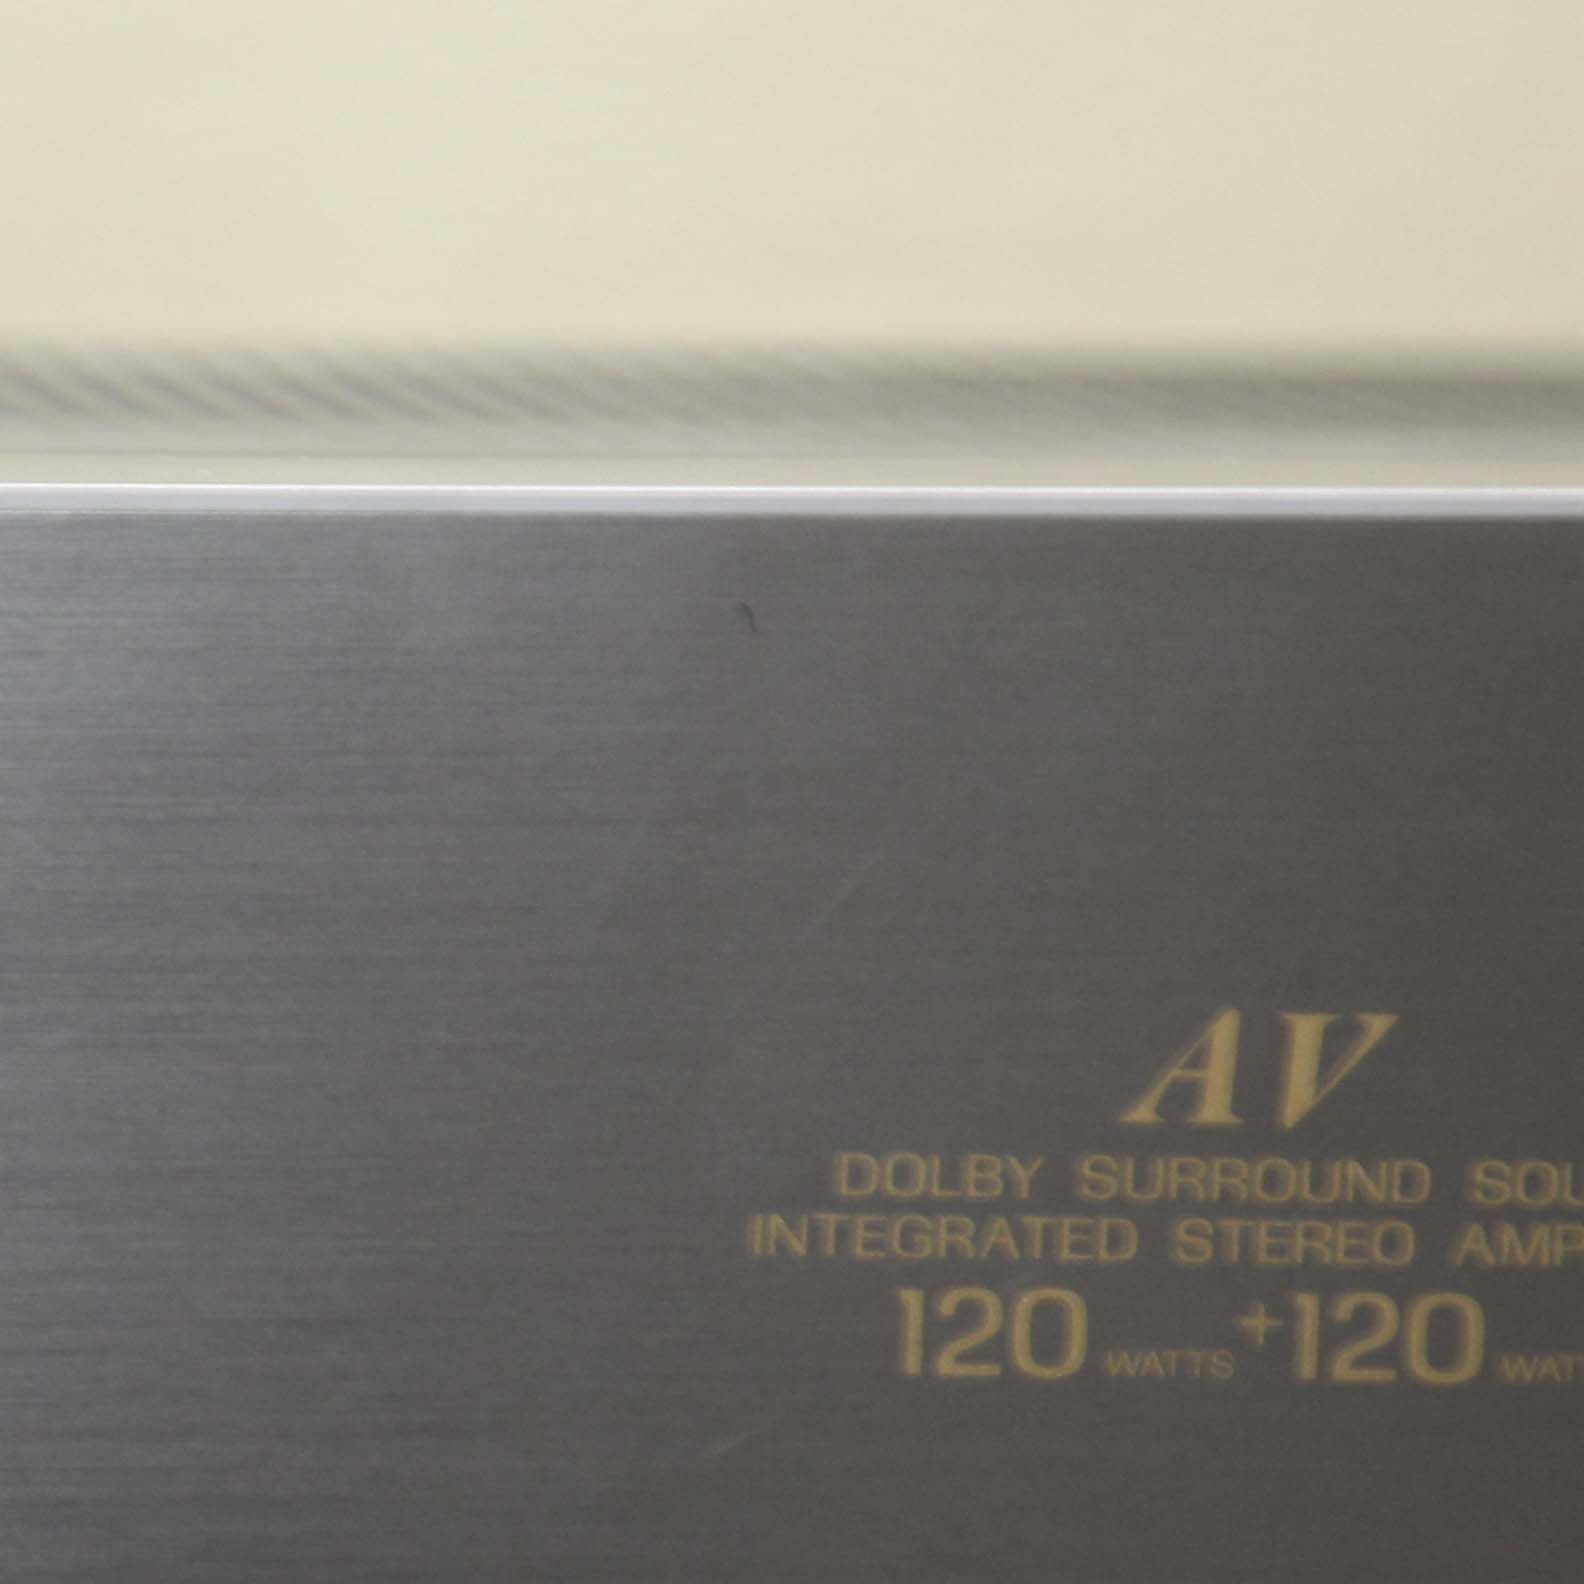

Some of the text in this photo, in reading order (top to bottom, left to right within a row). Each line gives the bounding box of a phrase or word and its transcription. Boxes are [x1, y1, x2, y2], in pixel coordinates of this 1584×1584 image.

[835, 1151, 1043, 1201] DOLBY
[1079, 1153, 1432, 1206] SURROUND
[750, 1212, 1138, 1262] INTEGRATED
[1174, 1219, 1417, 1267] STEREO
[896, 1287, 1089, 1378] 120
[1105, 1350, 1234, 1380] WATTS
